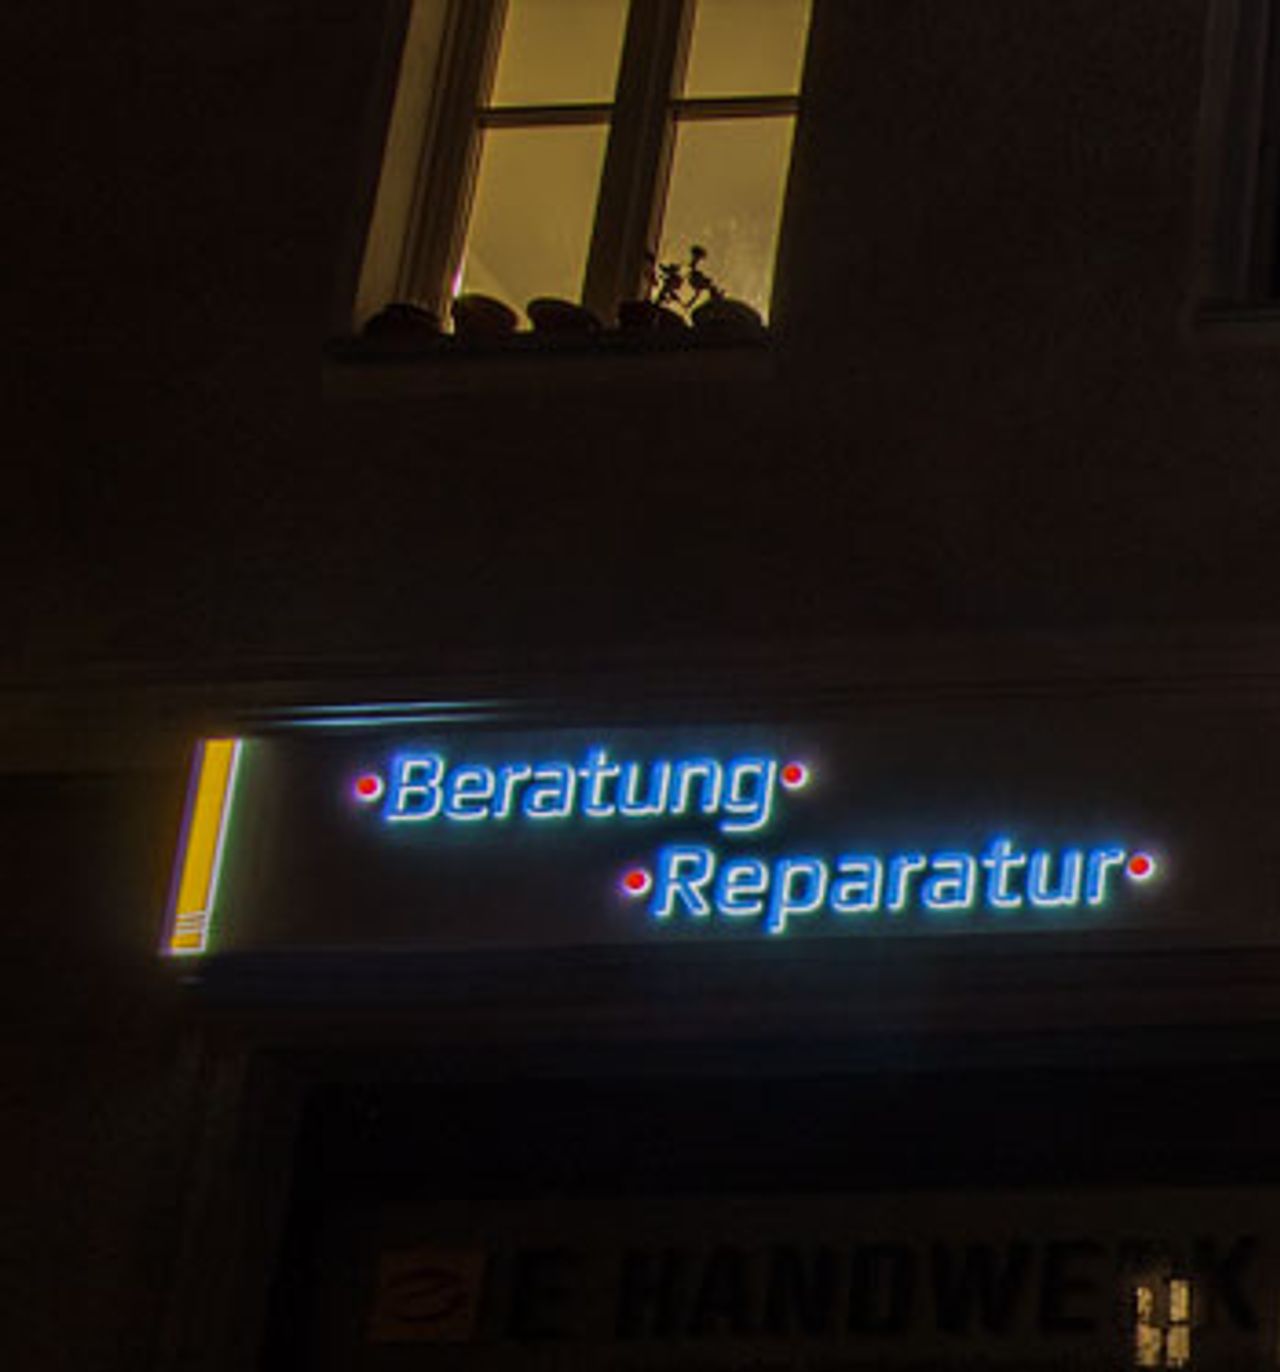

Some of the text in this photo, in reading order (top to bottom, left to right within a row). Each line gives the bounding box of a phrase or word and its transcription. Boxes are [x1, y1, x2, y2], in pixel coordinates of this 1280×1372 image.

[382, 748, 780, 832] Beratung
[650, 840, 1126, 934] Reparatur
[614, 1232, 1264, 1338] HANDWEK
